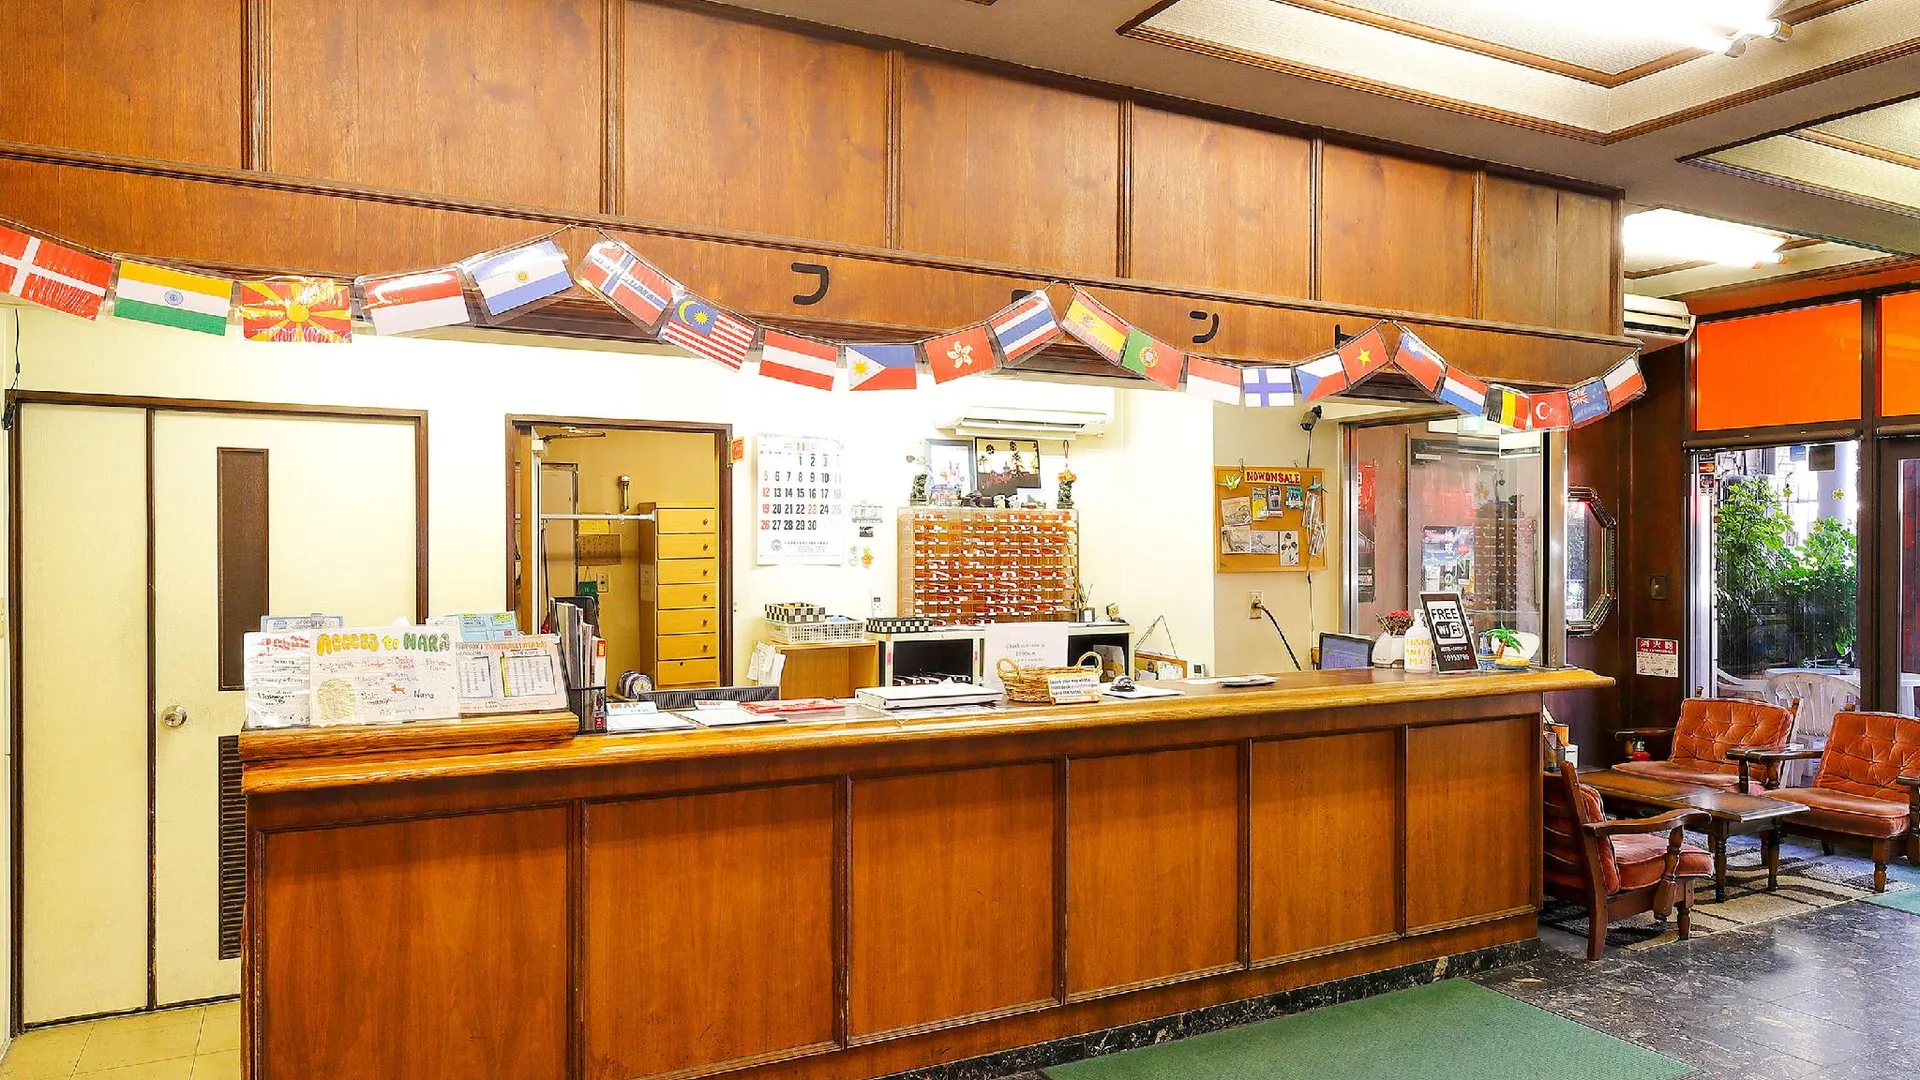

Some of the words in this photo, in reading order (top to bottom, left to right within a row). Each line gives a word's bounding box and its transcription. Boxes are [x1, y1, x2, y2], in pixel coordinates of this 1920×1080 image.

[810, 456, 816, 466] 2
[823, 457, 828, 467] 3
[764, 471, 769, 481] 5
[775, 471, 780, 481] 6
[787, 471, 791, 481] 7
[798, 472, 803, 482] 8
[810, 472, 815, 483] 9
[821, 473, 830, 483] 10
[763, 487, 770, 497] 12
[774, 487, 782, 497] 13
[785, 488, 793, 498] 14
[797, 488, 805, 498] 15
[809, 488, 817, 499] 16
[820, 489, 829, 499] 17
[762, 503, 770, 514] 19
[773, 504, 781, 514] 20
[784, 504, 793, 514] 21
[795, 504, 805, 514] 22
[807, 504, 817, 515] 23
[820, 504, 829, 515] 24
[760, 520, 770, 530] 26
[772, 520, 781, 530] 27
[784, 520, 793, 530] 28
[795, 520, 805, 531] 29
[807, 520, 817, 531] 30
[1431, 608, 1458, 619] FREE
[383, 635, 399, 650] to
[403, 632, 450, 652] NARA
